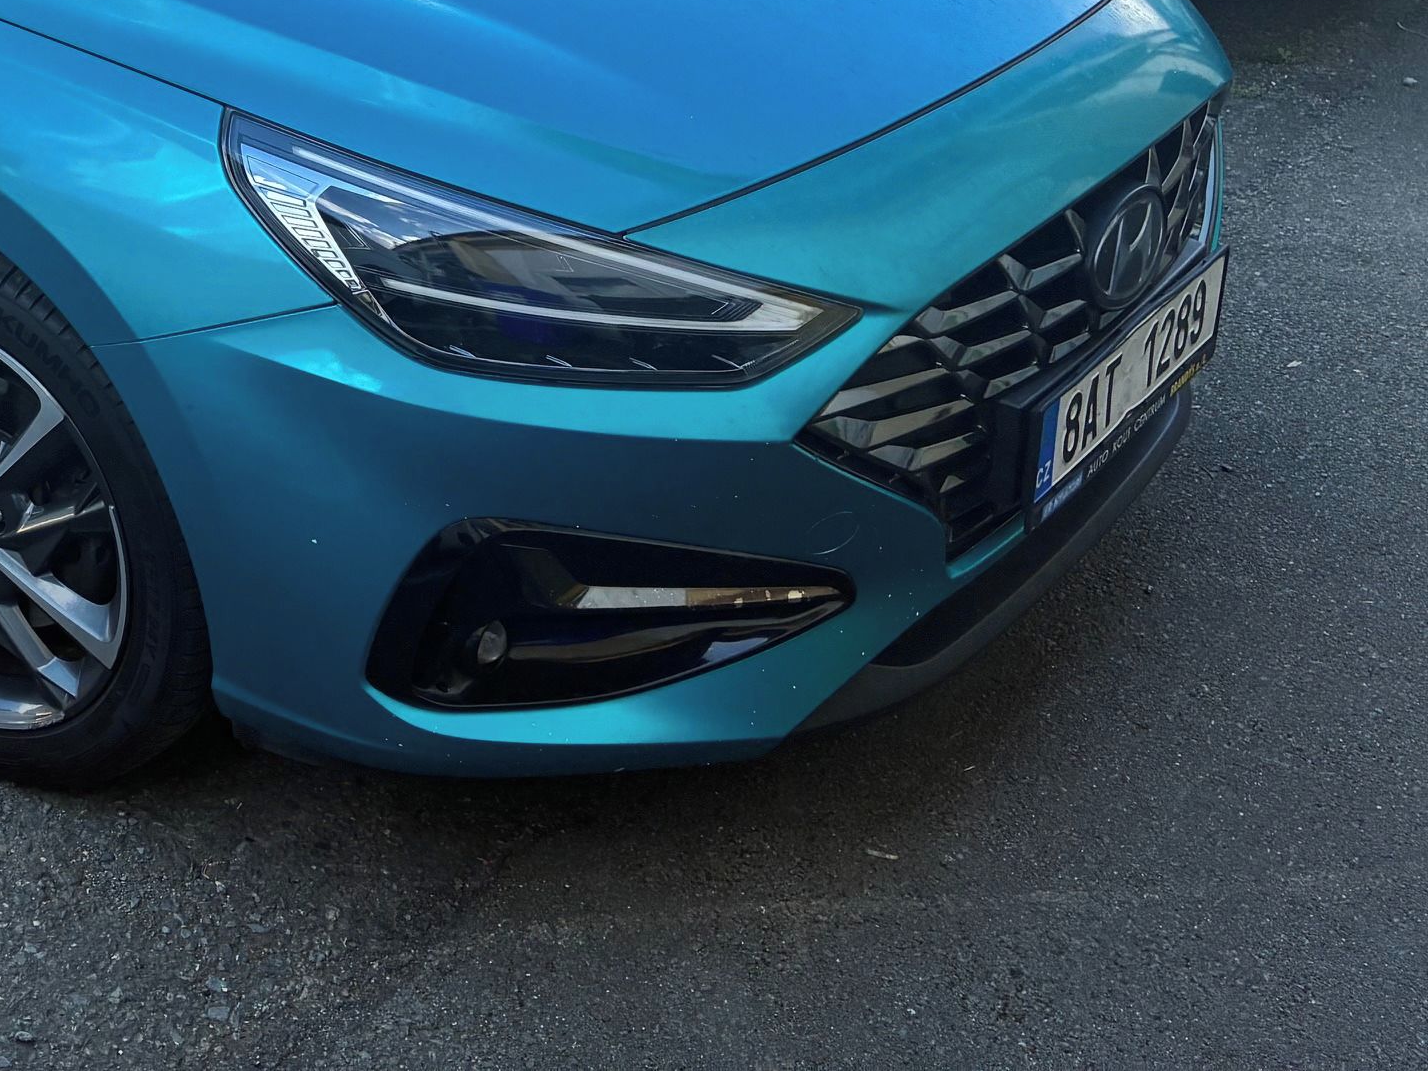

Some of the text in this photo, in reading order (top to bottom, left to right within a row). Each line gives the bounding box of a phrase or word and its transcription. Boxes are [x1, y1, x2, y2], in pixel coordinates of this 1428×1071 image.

[1062, 279, 1207, 463] 8AT 1289
[1035, 459, 1052, 489] CZ
